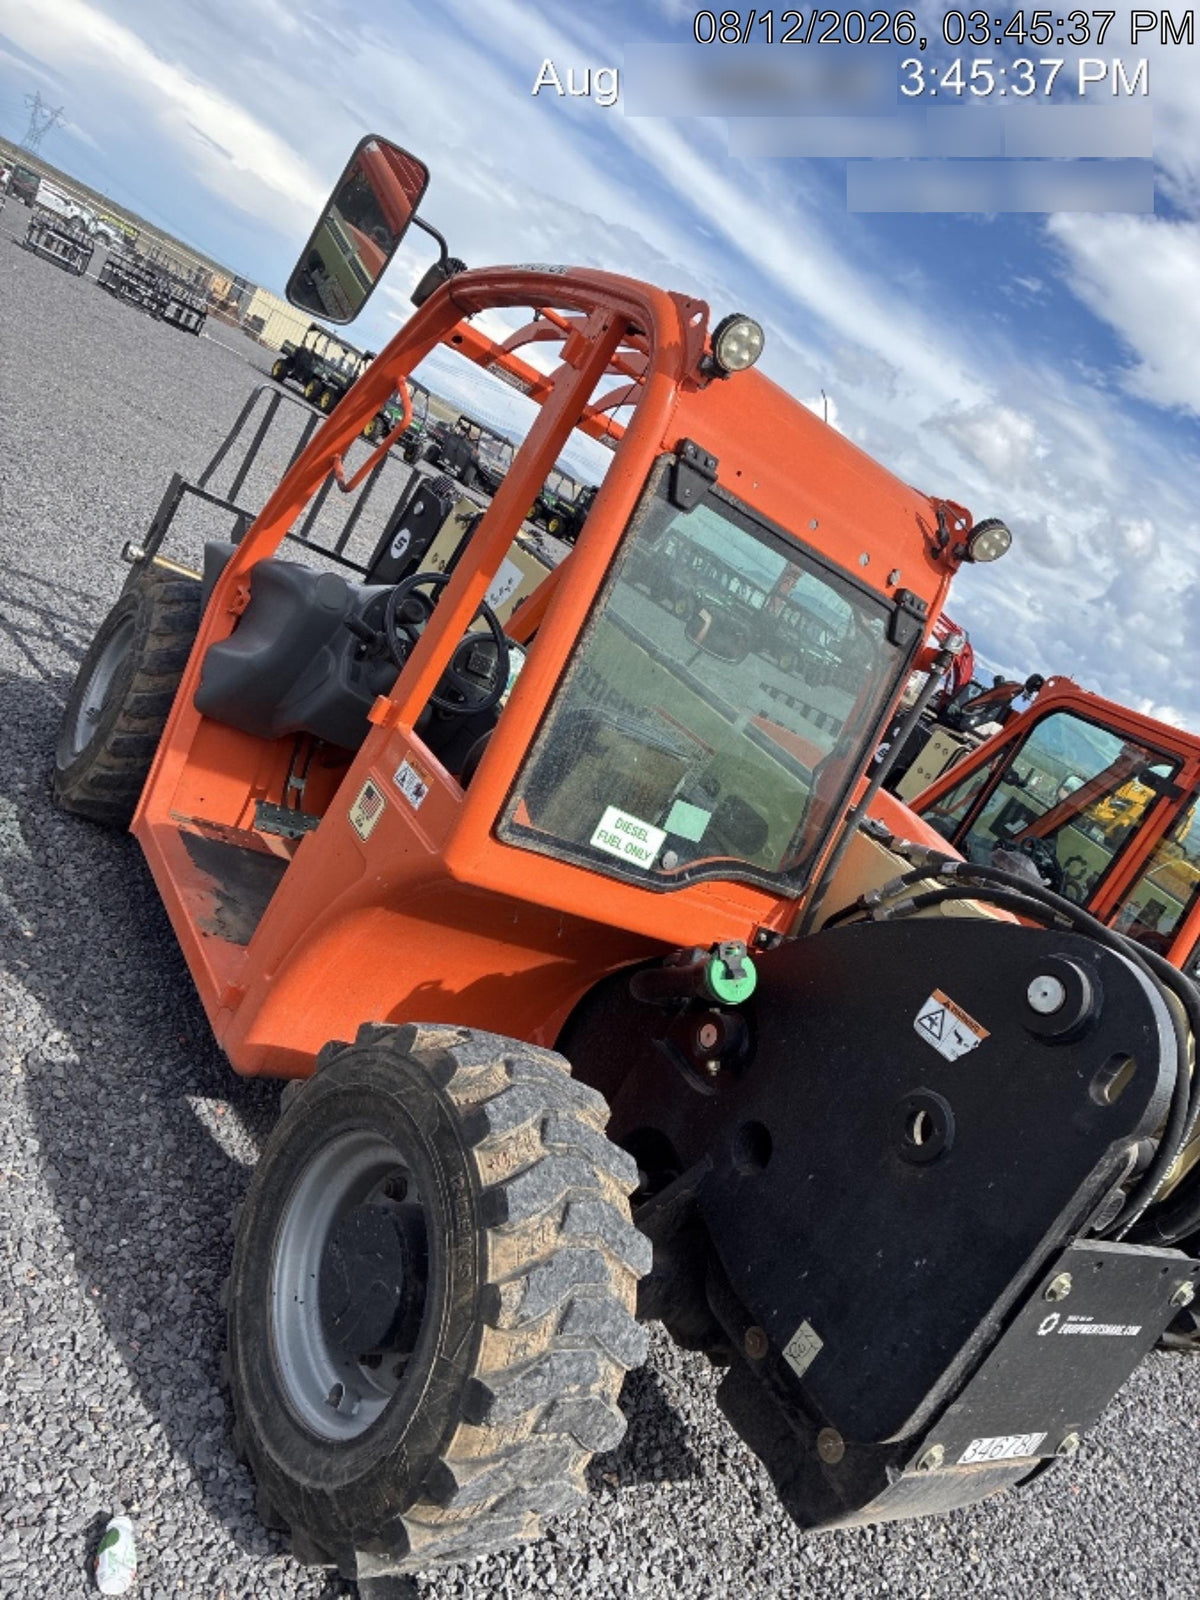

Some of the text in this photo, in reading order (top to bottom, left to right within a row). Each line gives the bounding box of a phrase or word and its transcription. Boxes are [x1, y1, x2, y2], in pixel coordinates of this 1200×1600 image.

[614, 816, 649, 843] DIESEL
[596, 829, 653, 861] FUEL ONLY
